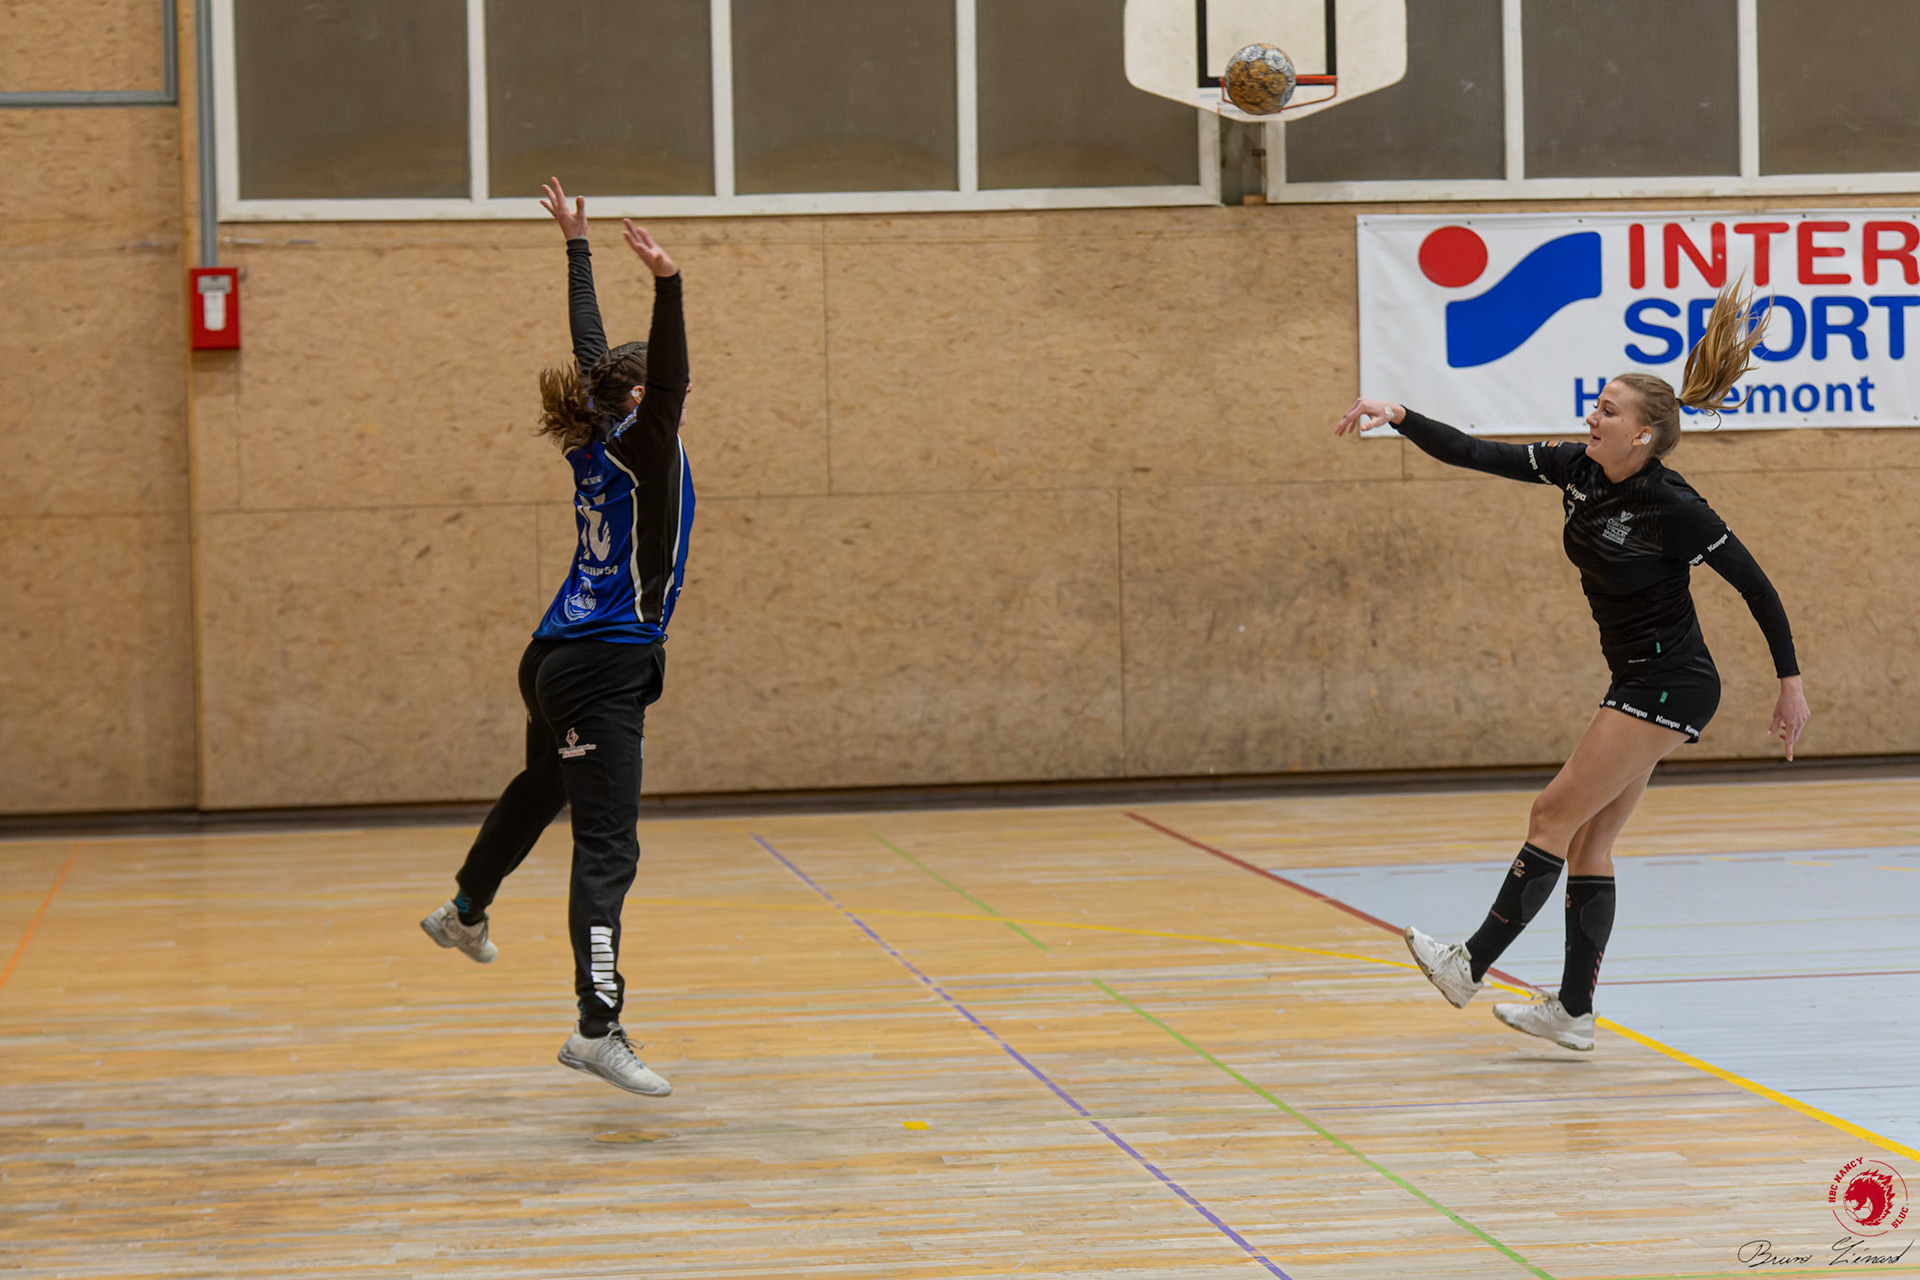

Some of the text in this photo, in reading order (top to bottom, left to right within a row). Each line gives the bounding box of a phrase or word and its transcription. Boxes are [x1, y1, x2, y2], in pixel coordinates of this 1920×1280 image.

[1629, 220, 1920, 289] INTER
[1574, 376, 1875, 417] Hemont
[1707, 533, 1728, 552] Kempa
[1622, 703, 1699, 737] Kempa Kempa Kemp
